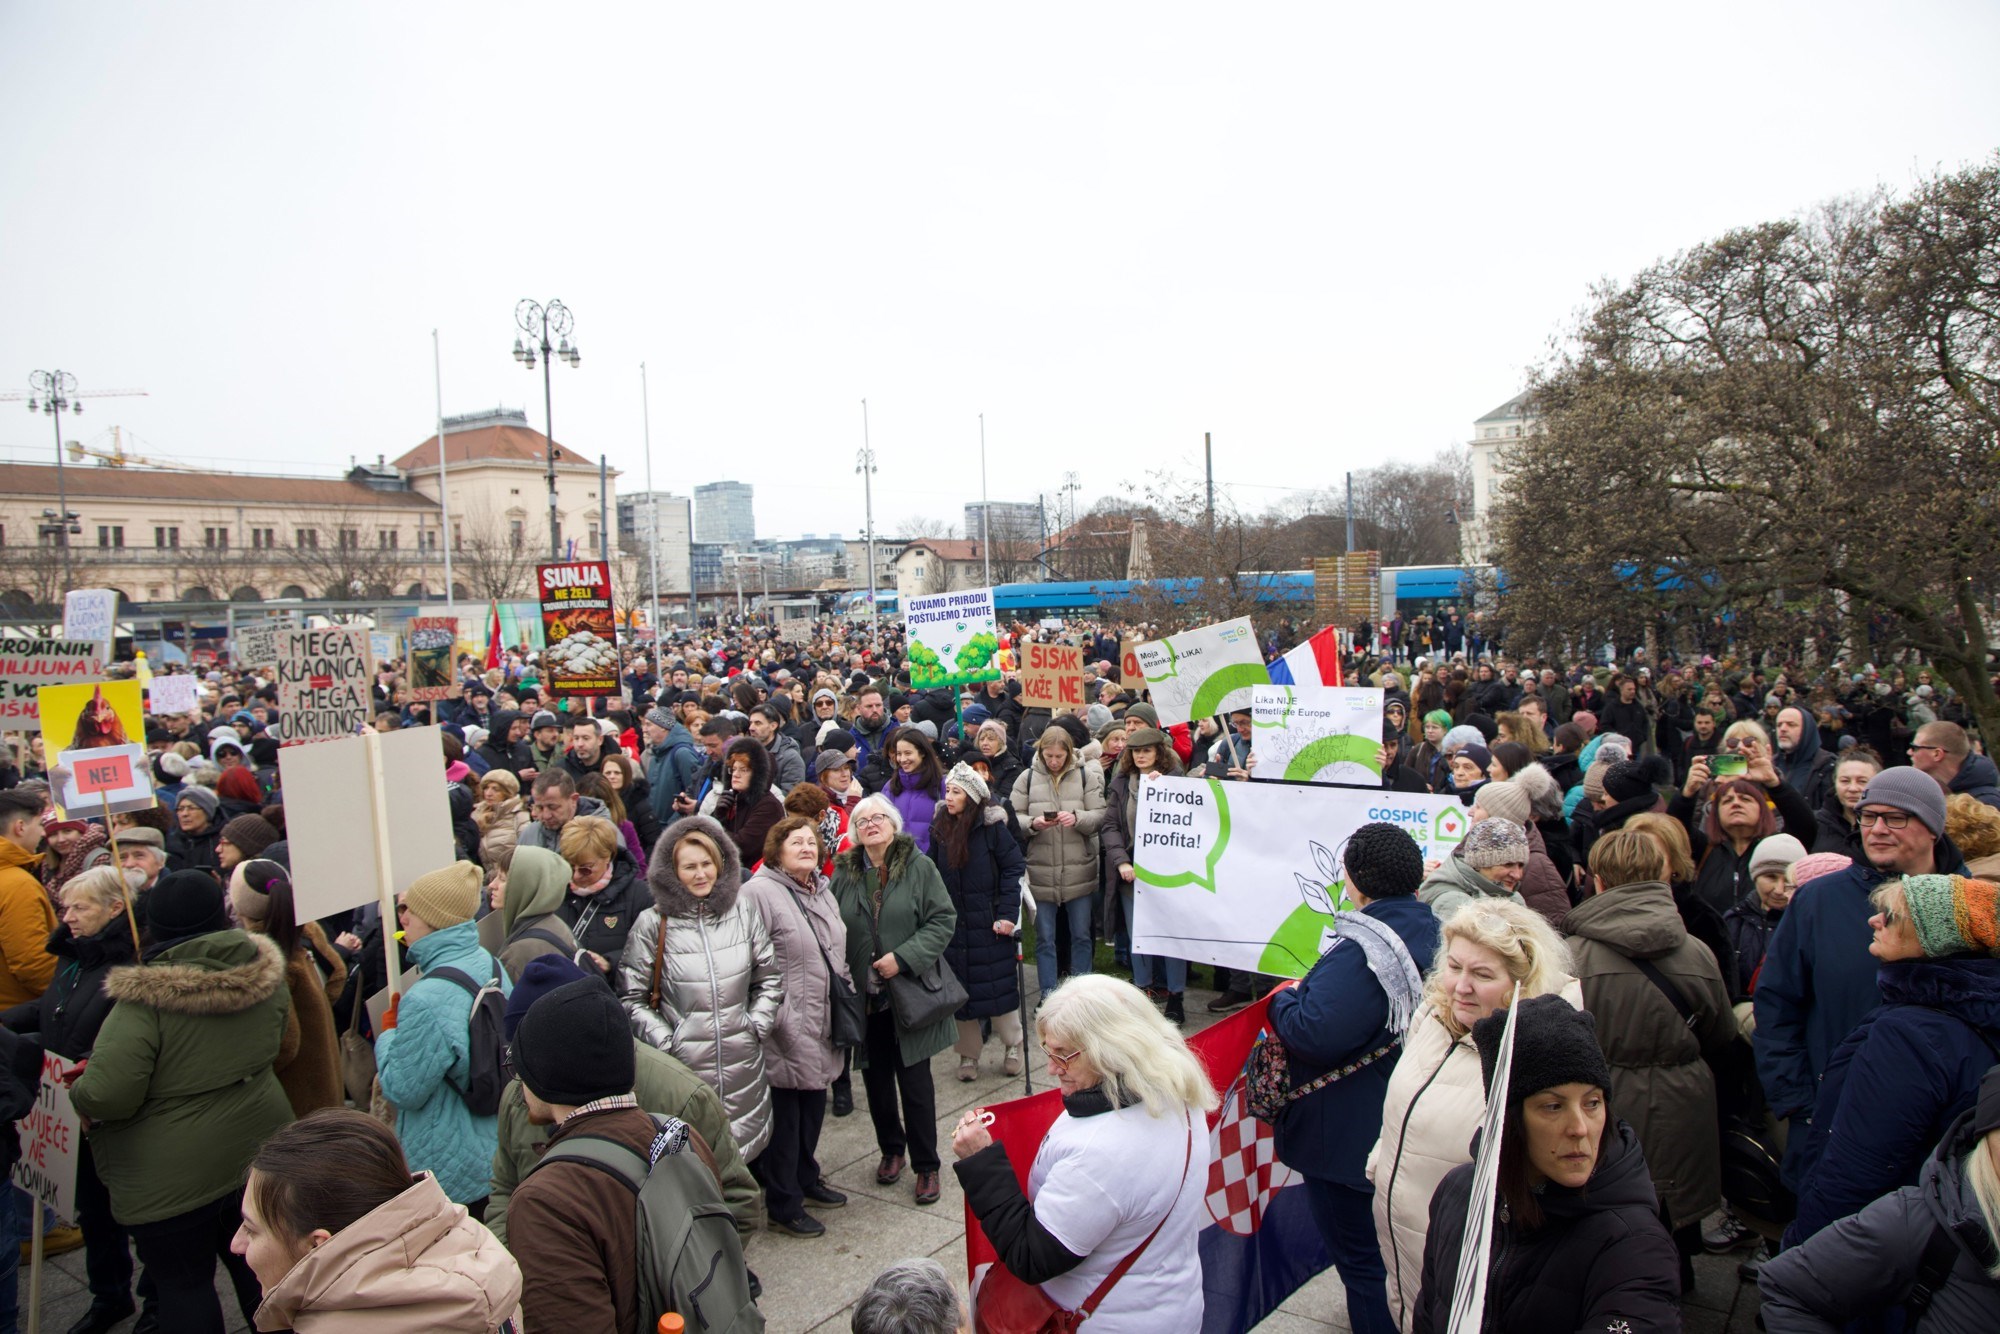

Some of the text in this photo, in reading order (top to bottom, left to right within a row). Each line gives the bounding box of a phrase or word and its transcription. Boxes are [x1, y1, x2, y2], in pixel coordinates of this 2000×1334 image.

[543, 565, 604, 588] SUNJA
[554, 586, 592, 600] NE ŽELI
[909, 593, 987, 612] ČUVAMO PRIRODU
[908, 606, 992, 624] POŠTUJEMO ŽIVOTE
[0, 638, 93, 657] ROJATNIH
[290, 632, 355, 657] MEGA
[1030, 645, 1079, 671] SISAK
[1140, 650, 1159, 661] Moja
[1144, 656, 1171, 668] stranka
[1181, 647, 1203, 659] LIKA!
[278, 658, 366, 684] KLAONICA
[299, 685, 360, 710] MEGA
[412, 687, 449, 701] SISAK
[1025, 674, 1084, 704] KAŽE NE!
[1255, 696, 1298, 706] Lika NIJE
[1255, 706, 1331, 719] smetlište Europe
[281, 708, 367, 740] OKRUTNOST
[88, 766, 118, 785] NE!
[1146, 787, 1204, 806] Priroda
[1149, 808, 1193, 826] iznad
[1368, 808, 1428, 824] GOSPIĆ
[1143, 832, 1201, 849] profita!
[1409, 825, 1428, 841] AŠ
[41, 1056, 64, 1084] MO
[28, 1138, 46, 1169] NE
[10, 1162, 59, 1209] MONIJAK
